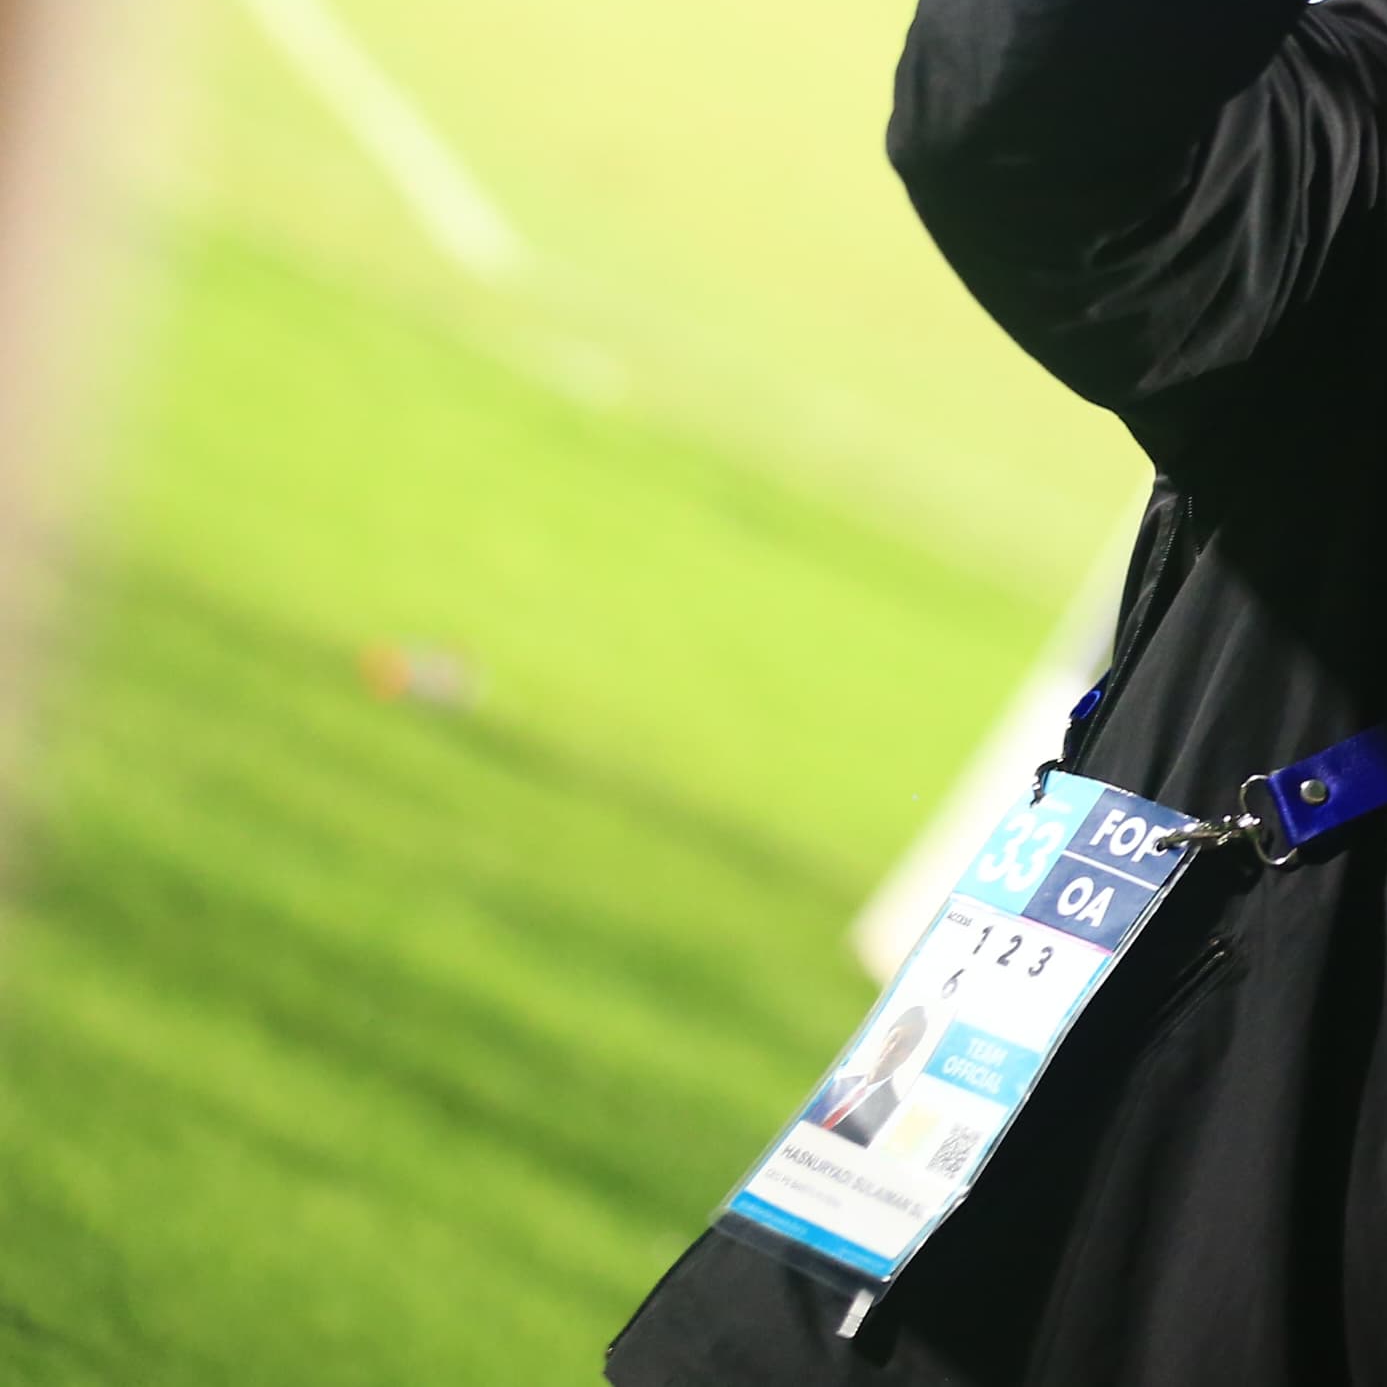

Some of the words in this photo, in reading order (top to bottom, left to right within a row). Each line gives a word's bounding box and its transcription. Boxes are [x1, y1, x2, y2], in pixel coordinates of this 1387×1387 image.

[976, 812, 1065, 893] 33
[1056, 876, 1116, 927] OA
[972, 924, 995, 956] 1
[996, 933, 1023, 967] 2
[1027, 945, 1054, 977] 3
[941, 967, 966, 999] 6
[942, 1054, 1003, 1095] OFFICIAL
